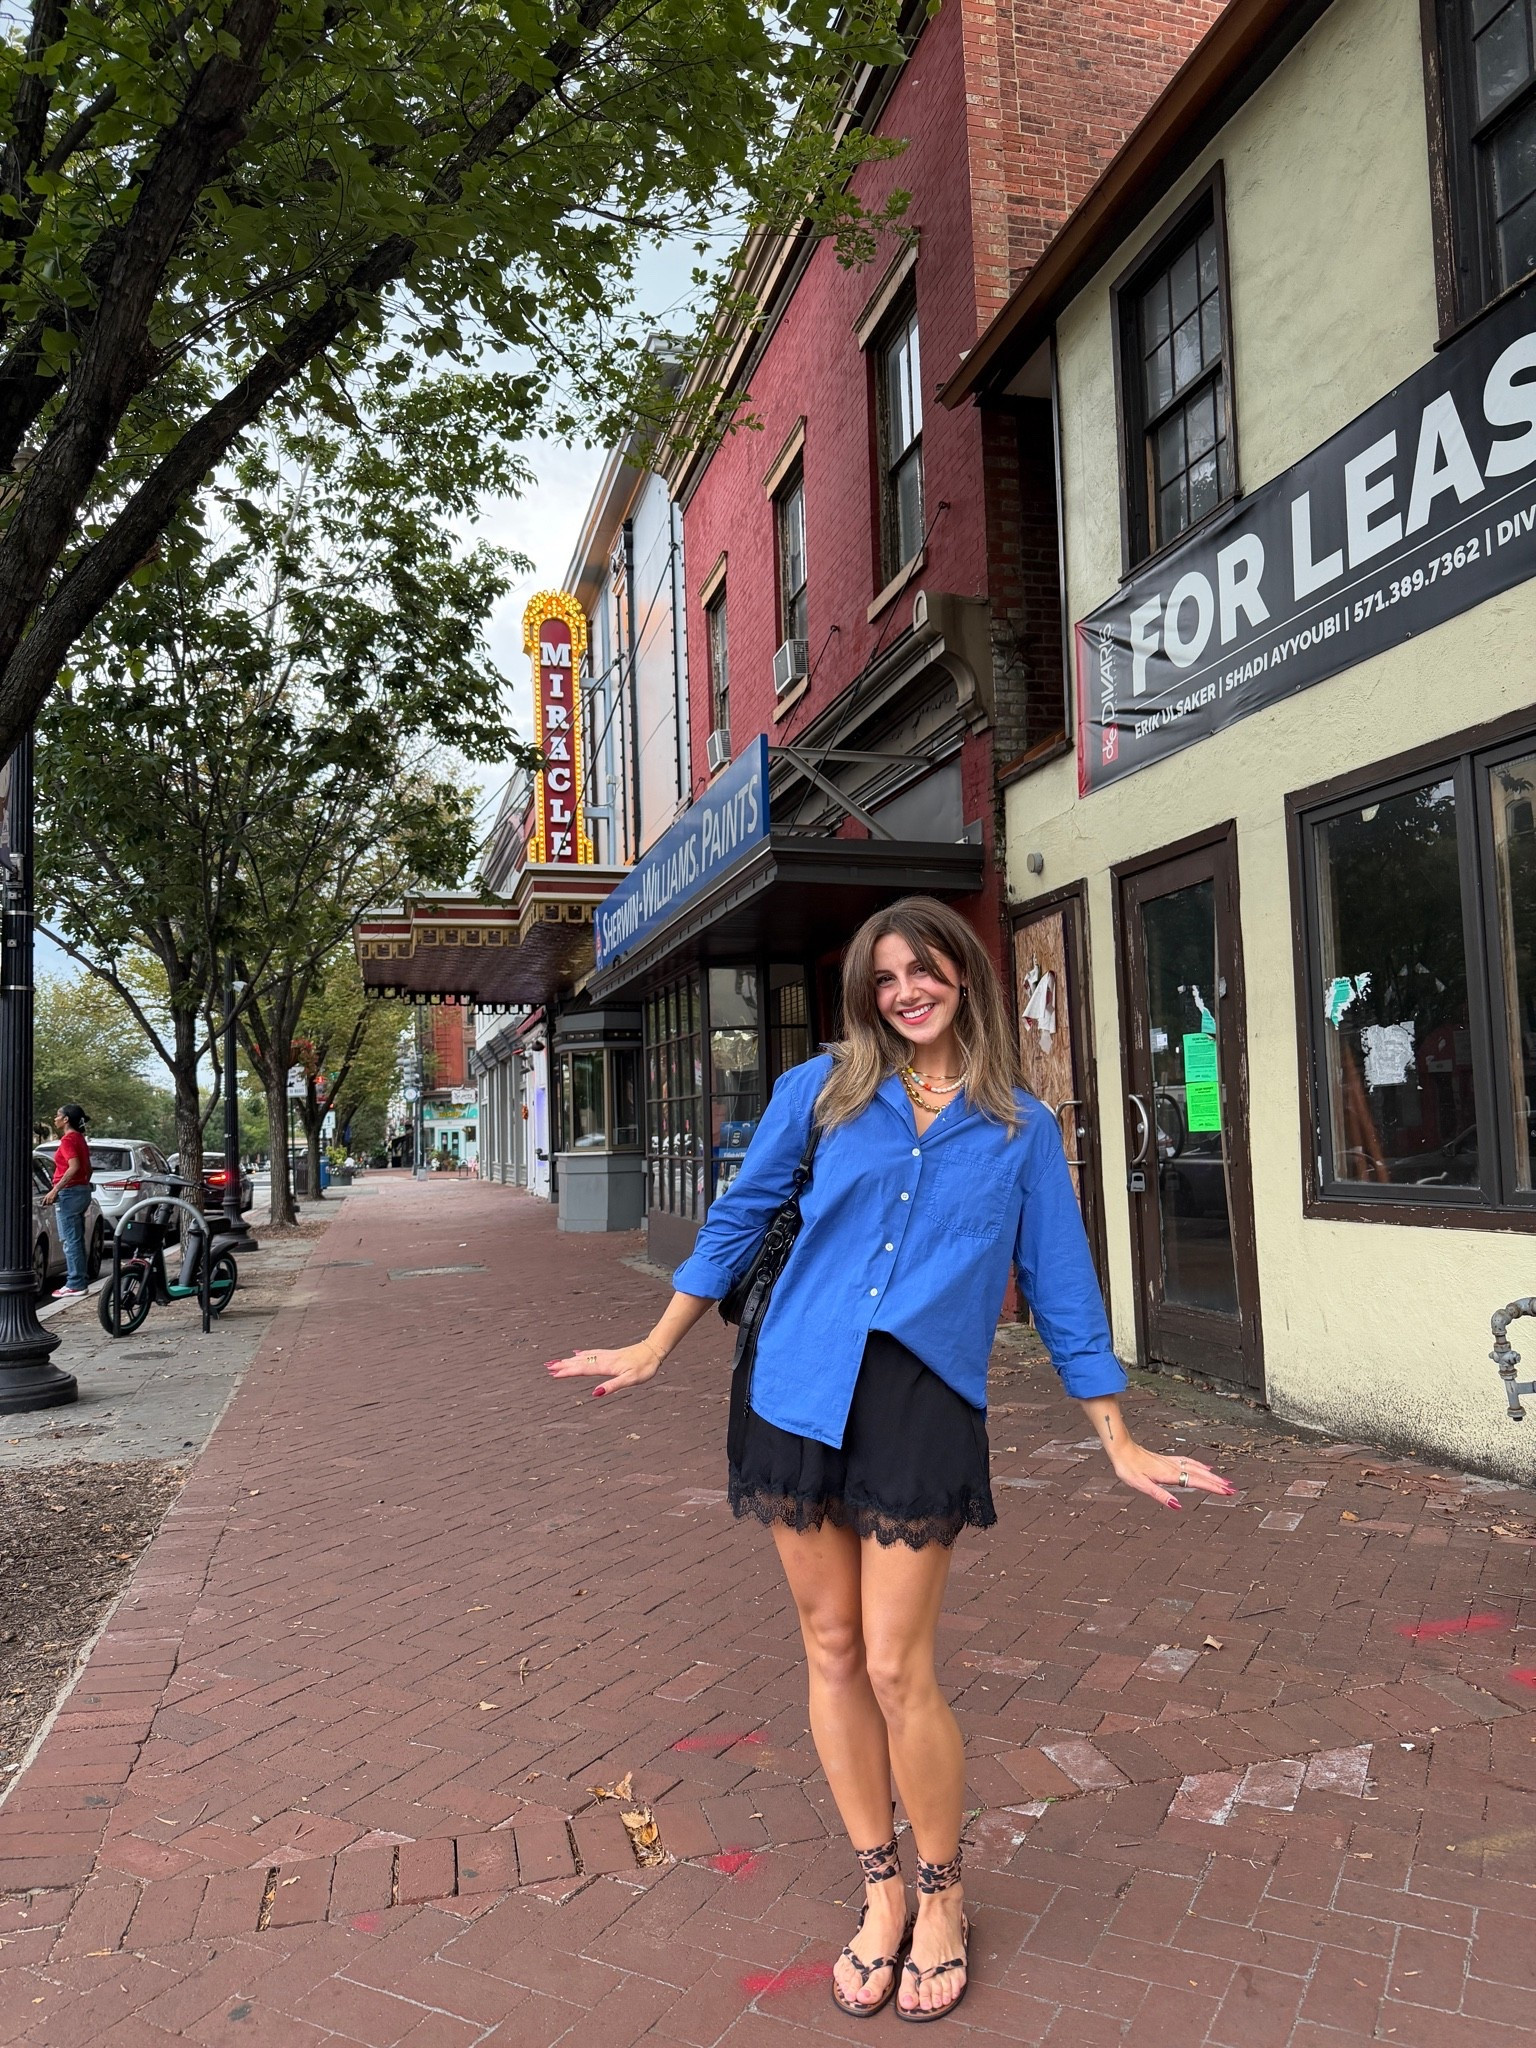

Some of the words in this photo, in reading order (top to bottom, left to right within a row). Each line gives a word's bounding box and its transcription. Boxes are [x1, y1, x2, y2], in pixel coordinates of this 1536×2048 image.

[1129, 532, 1271, 697] FOR
[1290, 331, 1536, 602] LEAS
[1099, 623, 1115, 726] DIVARIS
[1134, 712, 1160, 740] ERIK
[1161, 683, 1217, 726] ULSAKER
[1225, 652, 1268, 692] SHADI
[1270, 612, 1341, 668] AYYOUBI
[1353, 537, 1480, 623] 571.389.7362
[1496, 504, 1536, 547] DIV
[540, 641, 572, 856] MIRACLE
[701, 773, 758, 874] PAINTS
